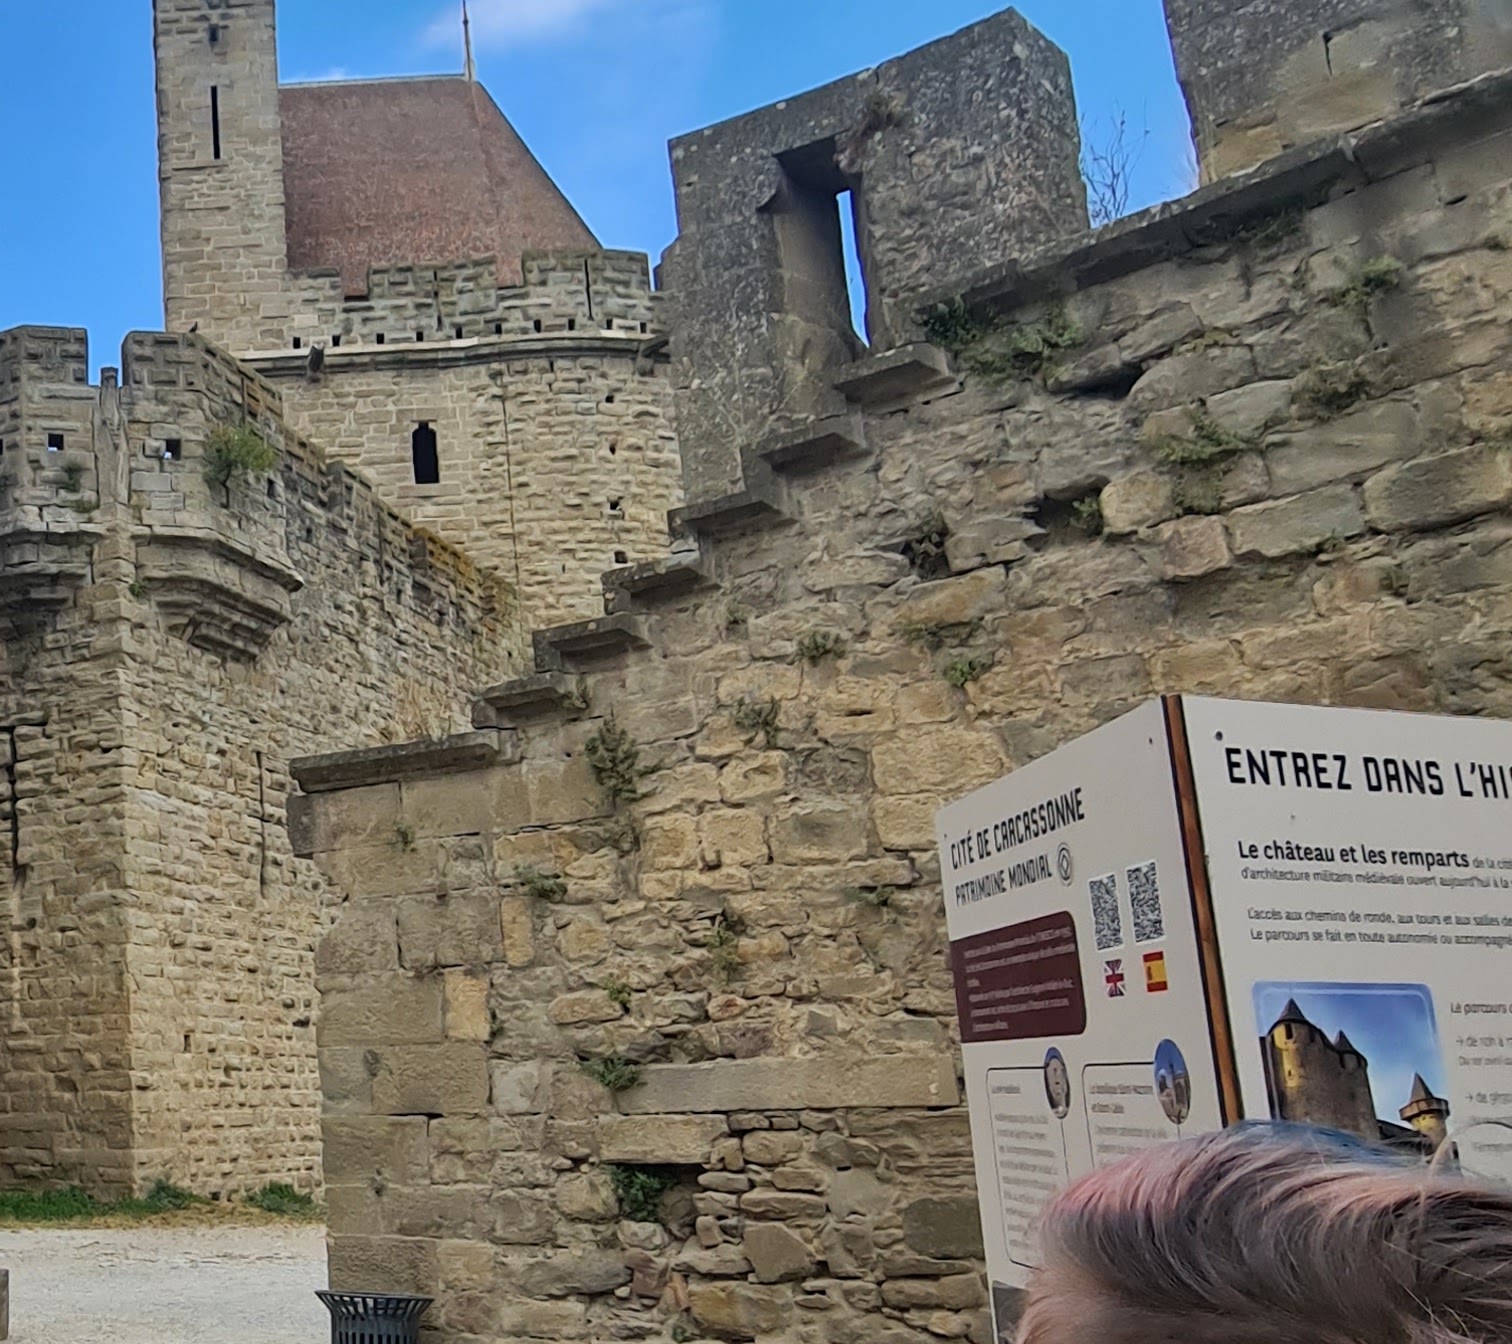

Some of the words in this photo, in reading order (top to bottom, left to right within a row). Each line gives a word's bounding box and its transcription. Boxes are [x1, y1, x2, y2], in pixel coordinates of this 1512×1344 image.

[1225, 747, 1352, 790] ENTREZ
[1362, 756, 1444, 796] DANS
[1454, 761, 1512, 799] L'HI
[951, 829, 975, 870] CITÉ
[976, 828, 992, 859] DE
[993, 787, 1085, 853] CARCASSONNE
[1238, 840, 1259, 859] Le
[1263, 839, 1335, 862] château
[1339, 846, 1359, 863] et
[1361, 844, 1388, 865] les
[1390, 850, 1470, 871] remparts
[1241, 866, 1310, 882] d'architecture
[955, 869, 1007, 906] PATRIMOINE
[1008, 854, 1053, 889] MONDIAL
[1251, 928, 1263, 940] Le
[1265, 930, 1310, 943] parcours
